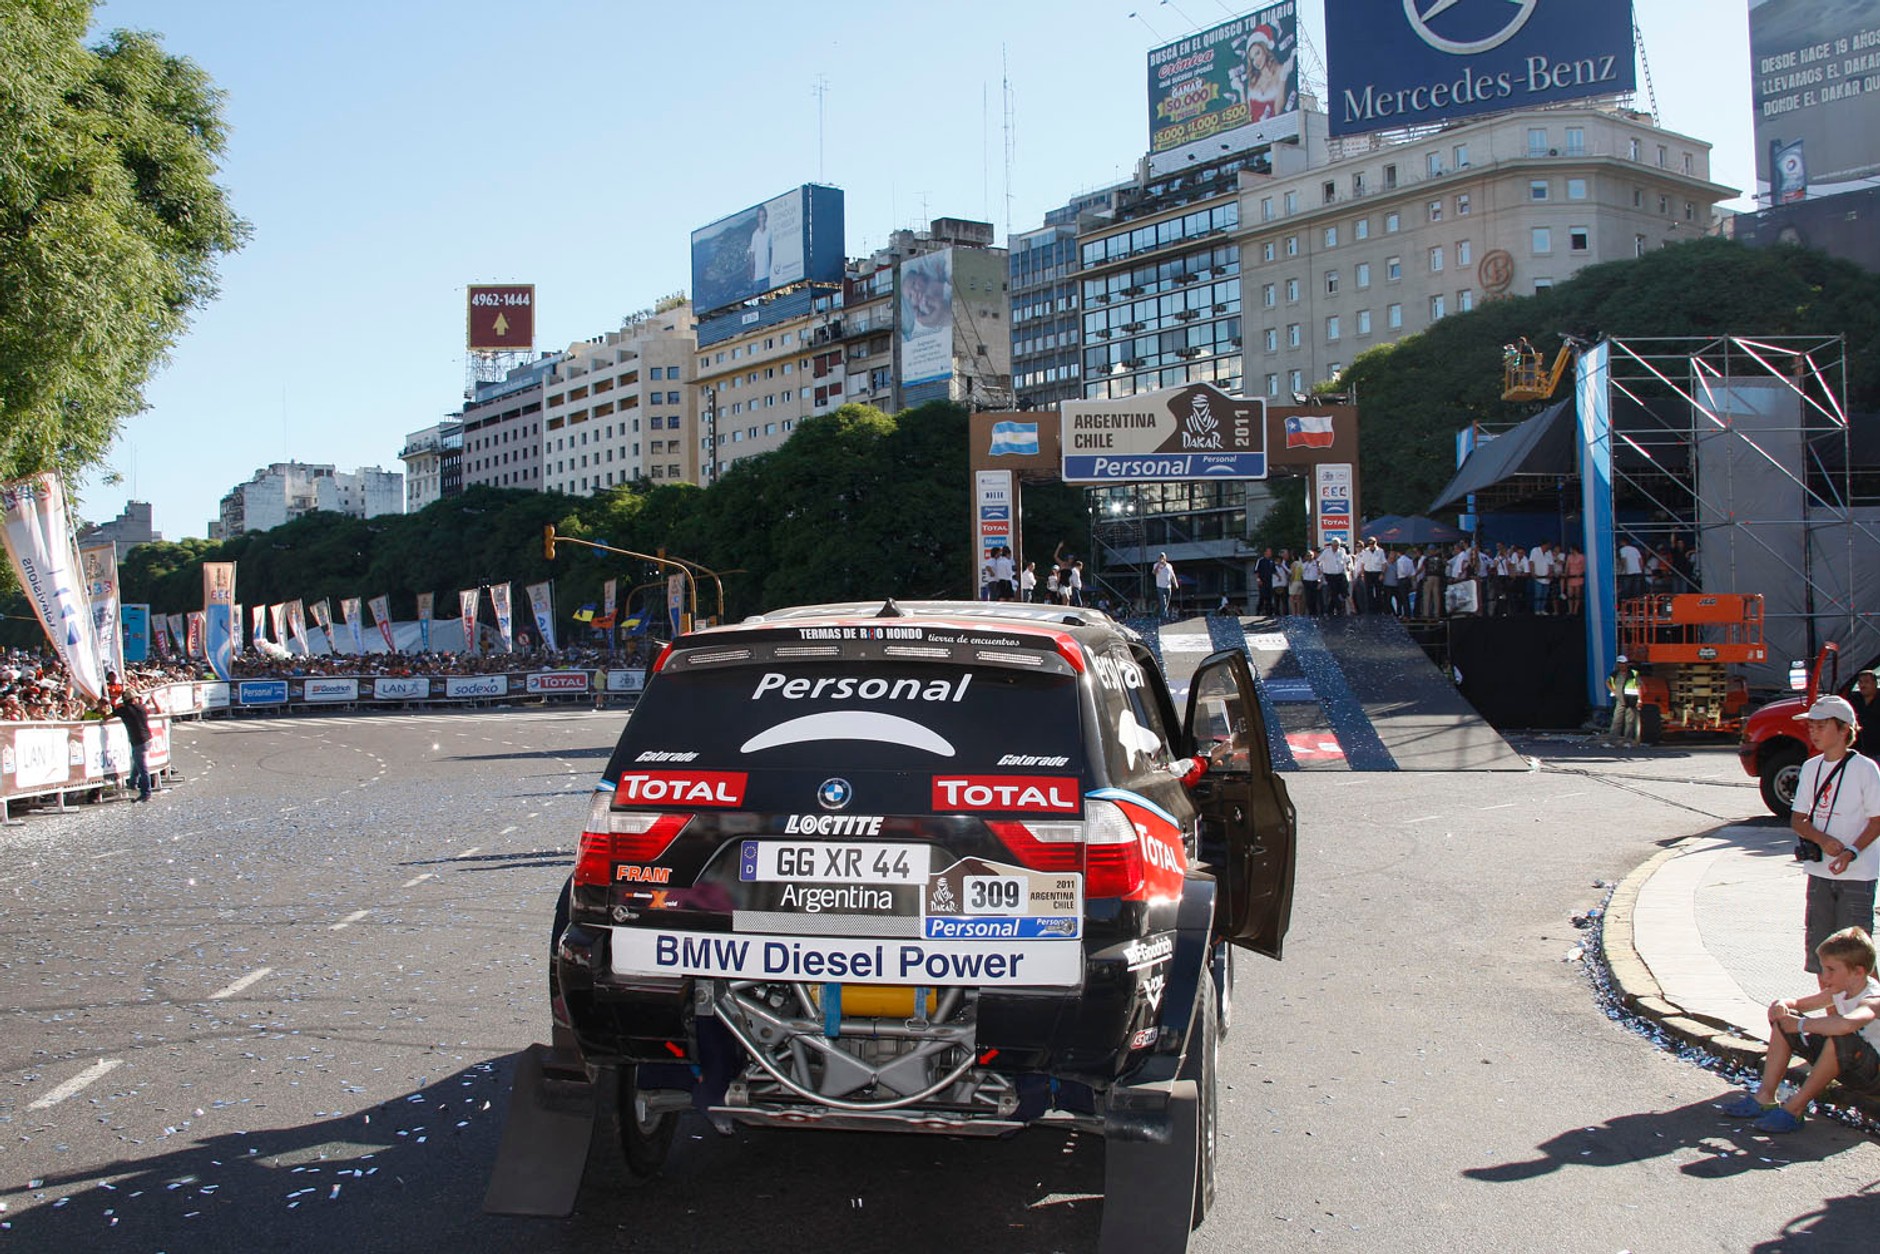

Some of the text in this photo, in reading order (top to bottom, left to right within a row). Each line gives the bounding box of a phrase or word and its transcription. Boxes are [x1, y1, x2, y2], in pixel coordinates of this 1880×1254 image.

[1179, 41, 1190, 58] EN
[1192, 38, 1202, 51] EL
[1203, 24, 1242, 46] QUIOSCO
[1245, 16, 1256, 31] TU
[1261, 2, 1294, 24] DIARIO
[1761, 52, 1797, 74] DESDE
[1800, 43, 1830, 64] HACE
[1834, 38, 1848, 55] 19
[1762, 66, 1823, 95] LLEVAMOS
[1827, 63, 1840, 78] EL
[1343, 55, 1617, 123] Mercedes-Benz
[1763, 94, 1800, 116] DONDE
[1803, 91, 1817, 106] EL
[1821, 80, 1860, 103] DAKAR
[472, 293, 530, 306] 4962-1444
[1074, 413, 1156, 429] ARGENTINA
[1234, 409, 1250, 447] 2011
[1074, 433, 1114, 448] CHILE
[1181, 431, 1224, 449] DAKAR
[1093, 455, 1192, 476] Personal
[1202, 455, 1237, 463] Personal
[799, 628, 842, 640] TERMAS
[843, 628, 857, 639] DE
[886, 628, 923, 640] HONDO
[928, 633, 1021, 646] tierra de encuentros
[382, 683, 406, 693] LAN
[455, 682, 498, 695] sodexo
[544, 676, 585, 687] TOTAL
[752, 673, 973, 702] Personal
[243, 686, 273, 697] Personal
[634, 751, 700, 762] Gatorade
[997, 754, 1070, 767] Gatorade
[624, 775, 737, 802] TOTAL
[937, 780, 1074, 808] TOTAL
[784, 815, 885, 835] LOCTITE
[1134, 822, 1185, 876] TOTAL
[746, 864, 754, 874] D
[777, 847, 910, 878] GG XR 44
[616, 865, 671, 883] FRAM
[1056, 880, 1075, 889] 2011
[780, 884, 893, 912] Argentina
[971, 880, 1020, 909] 309
[1030, 892, 1075, 901] ARGENTINA
[1053, 901, 1074, 910] CHILE
[931, 919, 1021, 936] Personal
[656, 935, 1024, 980] BMW Diesel Power
